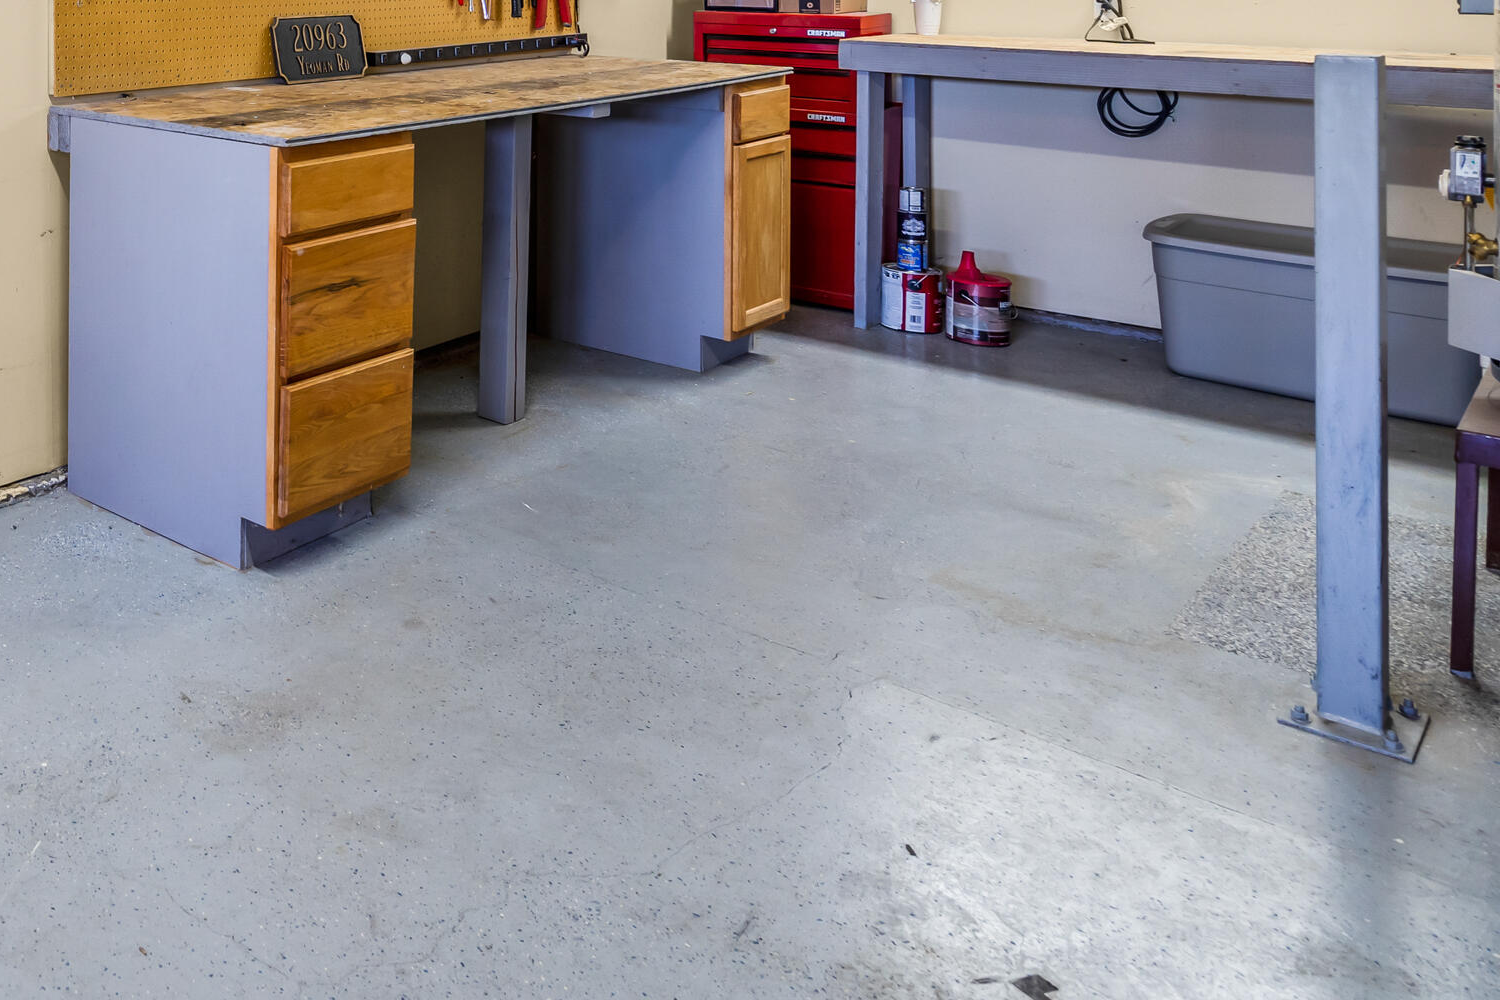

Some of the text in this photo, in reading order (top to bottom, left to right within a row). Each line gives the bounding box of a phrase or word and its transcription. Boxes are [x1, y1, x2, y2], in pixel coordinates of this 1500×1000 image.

[291, 21, 347, 53] 20963
[807, 29, 846, 38] CRAFTSMAN
[807, 113, 846, 123] CRAFTSMAN
